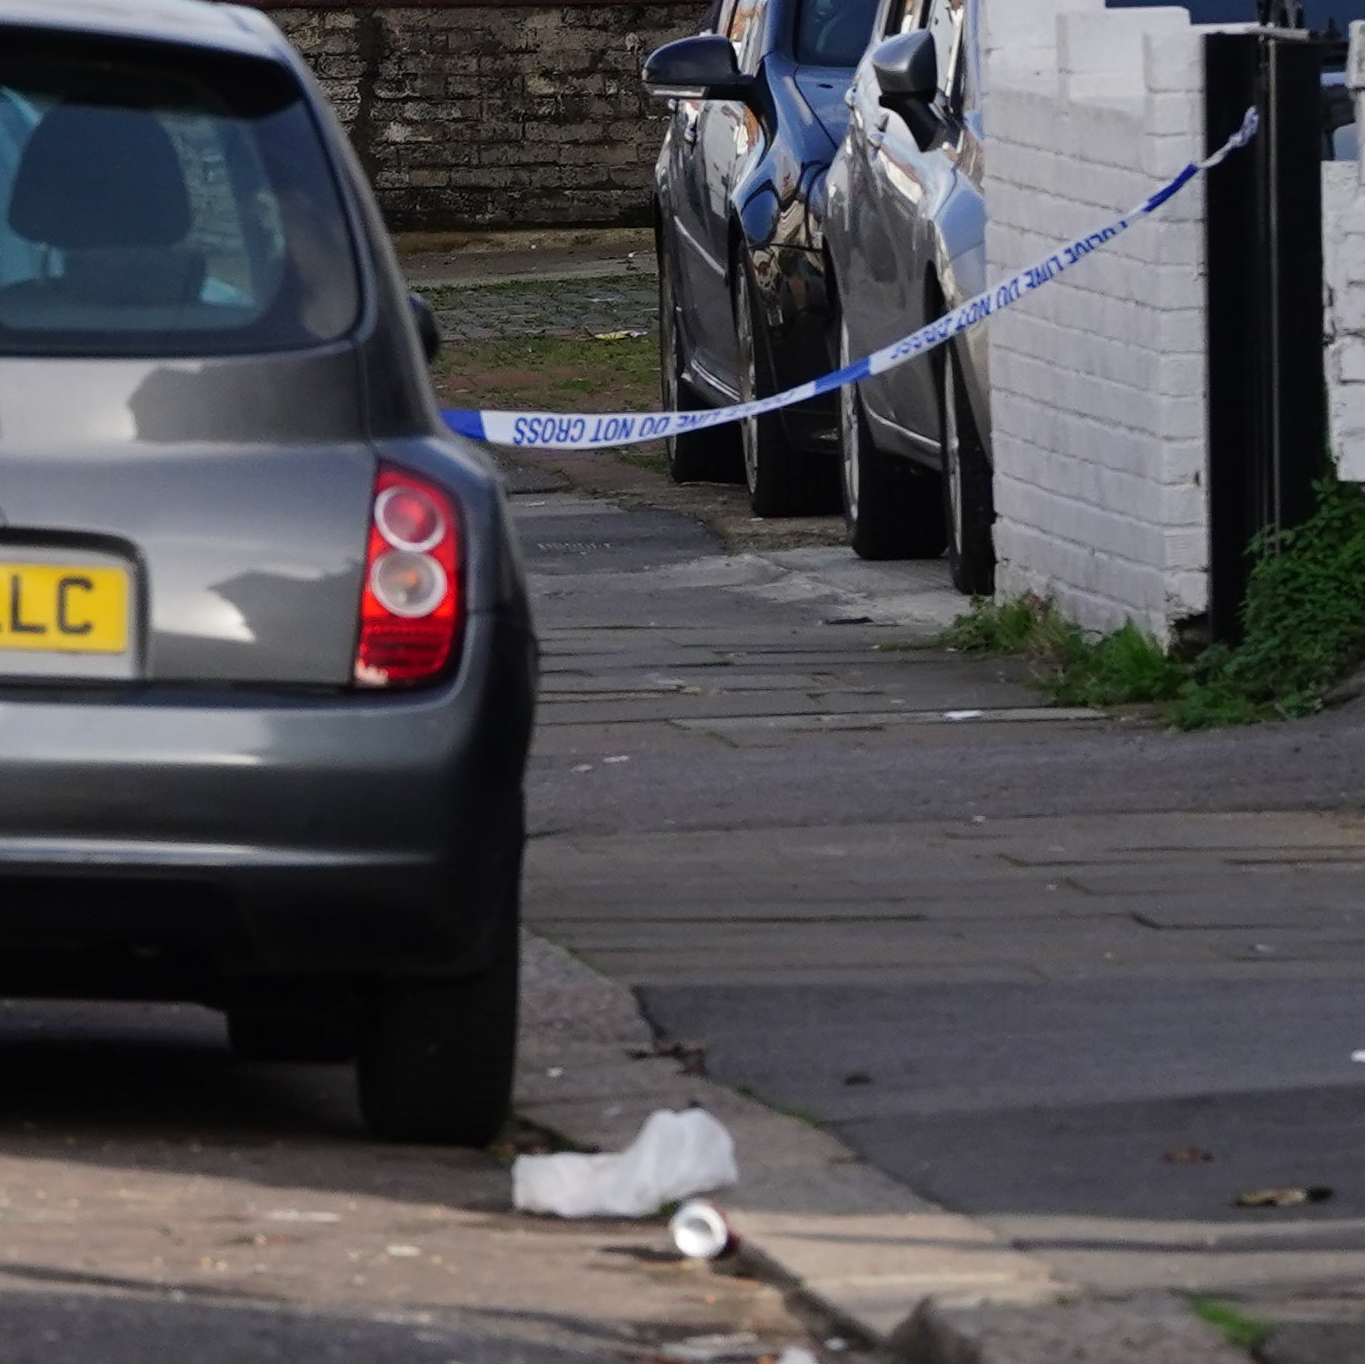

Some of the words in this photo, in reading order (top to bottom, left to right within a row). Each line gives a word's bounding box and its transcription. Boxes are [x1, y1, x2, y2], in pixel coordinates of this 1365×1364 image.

[513, 416, 581, 446] CROSS
[589, 417, 631, 443] NOT
[640, 415, 671, 439] DO
